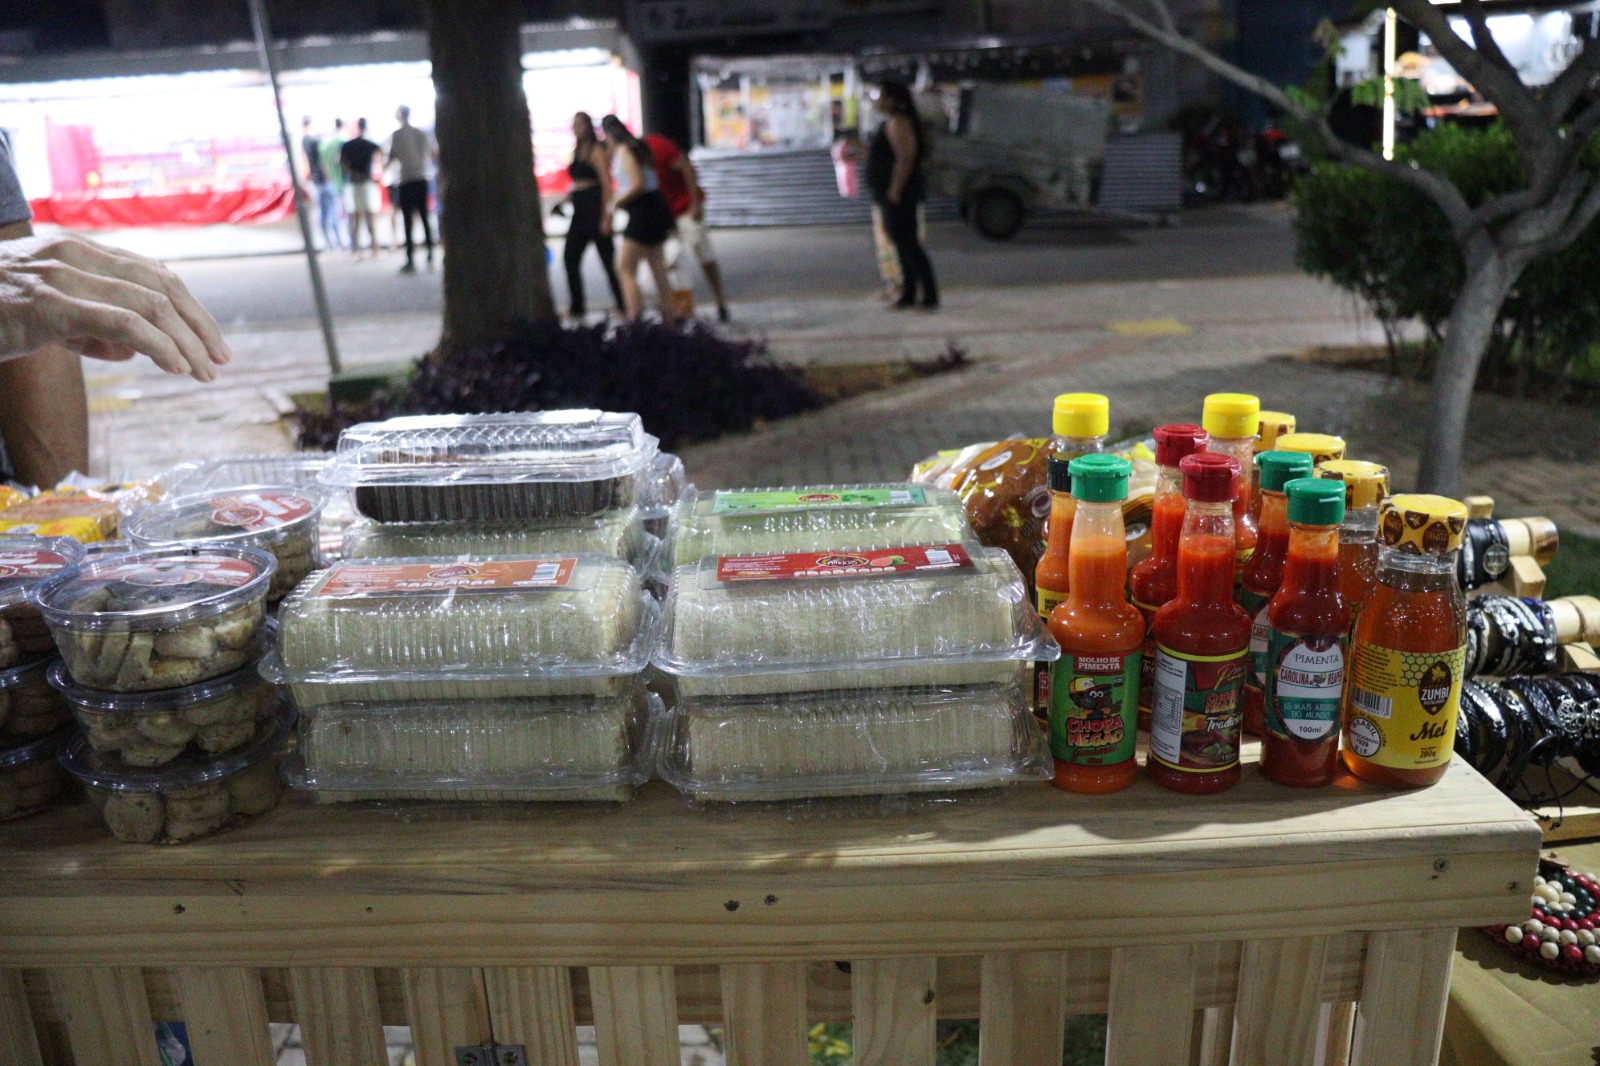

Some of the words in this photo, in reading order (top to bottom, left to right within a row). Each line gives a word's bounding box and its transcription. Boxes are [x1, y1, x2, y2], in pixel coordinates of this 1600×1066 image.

[1294, 653, 1339, 665] PIMENTA
[1280, 668, 1309, 685] CAROLINA
[1420, 686, 1450, 701] ZUMBI
[1291, 710, 1302, 718] DO
[1305, 711, 1330, 719] MUNDO
[1294, 703, 1312, 711] MAIS
[1067, 715, 1124, 733] CHORA
[1299, 725, 1322, 733] 100ml
[1352, 718, 1377, 737] BRASIL
[1409, 720, 1448, 741] Mel
